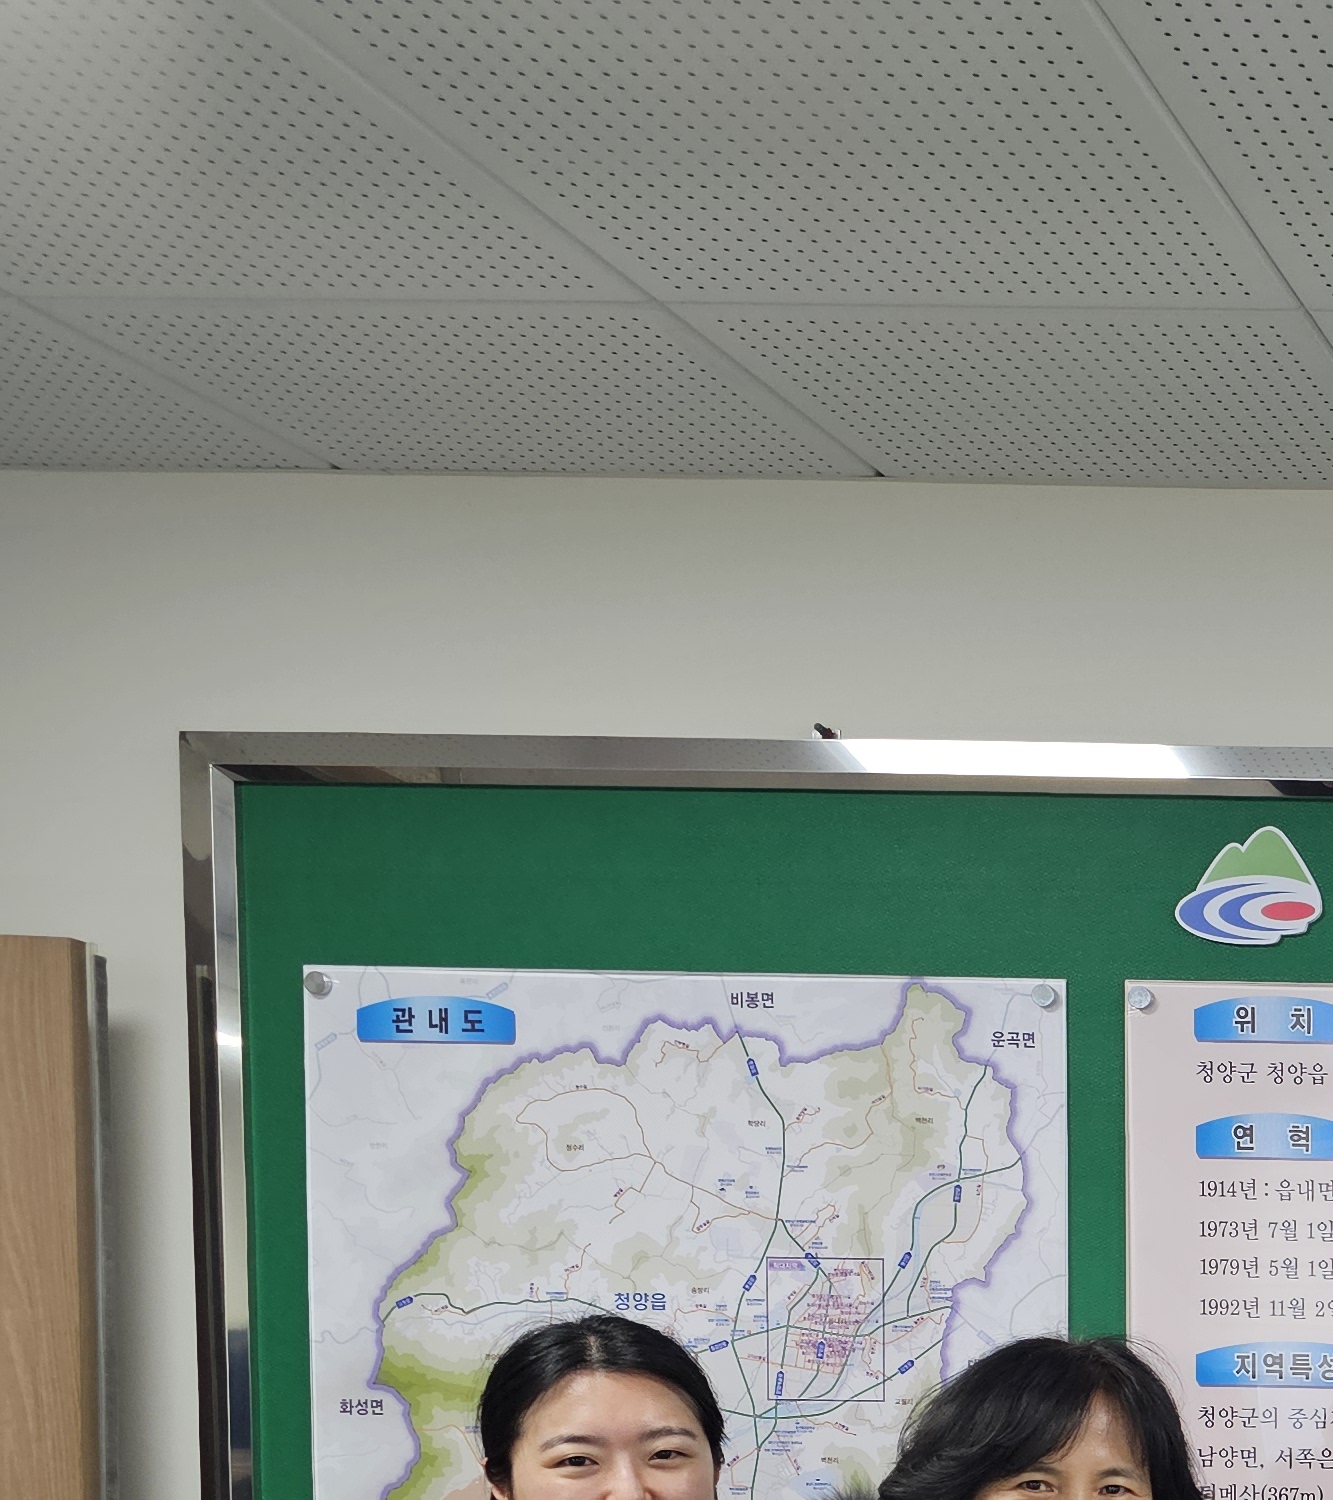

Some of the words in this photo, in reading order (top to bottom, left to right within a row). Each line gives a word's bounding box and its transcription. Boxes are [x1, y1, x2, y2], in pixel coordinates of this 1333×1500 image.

[730, 991, 775, 1009] 비봉면
[990, 1030, 1036, 1049] 운곡면
[1196, 1060, 1258, 1084] 청양군
[1266, 1061, 1329, 1086] 청양읍
[1198, 1177, 1258, 1201] 1914년
[1199, 1218, 1259, 1241] 1973년
[1268, 1219, 1299, 1242] 7월
[1199, 1256, 1260, 1279] 1979년
[1268, 1256, 1300, 1280] 5월
[614, 1292, 667, 1314] 청양읍
[1199, 1296, 1261, 1319] 1992년
[1269, 1297, 1307, 1320] 11월
[339, 1398, 384, 1416] 화성면
[1197, 1405, 1278, 1430] 청양군의
[1195, 1445, 1264, 1469] 남양면,
